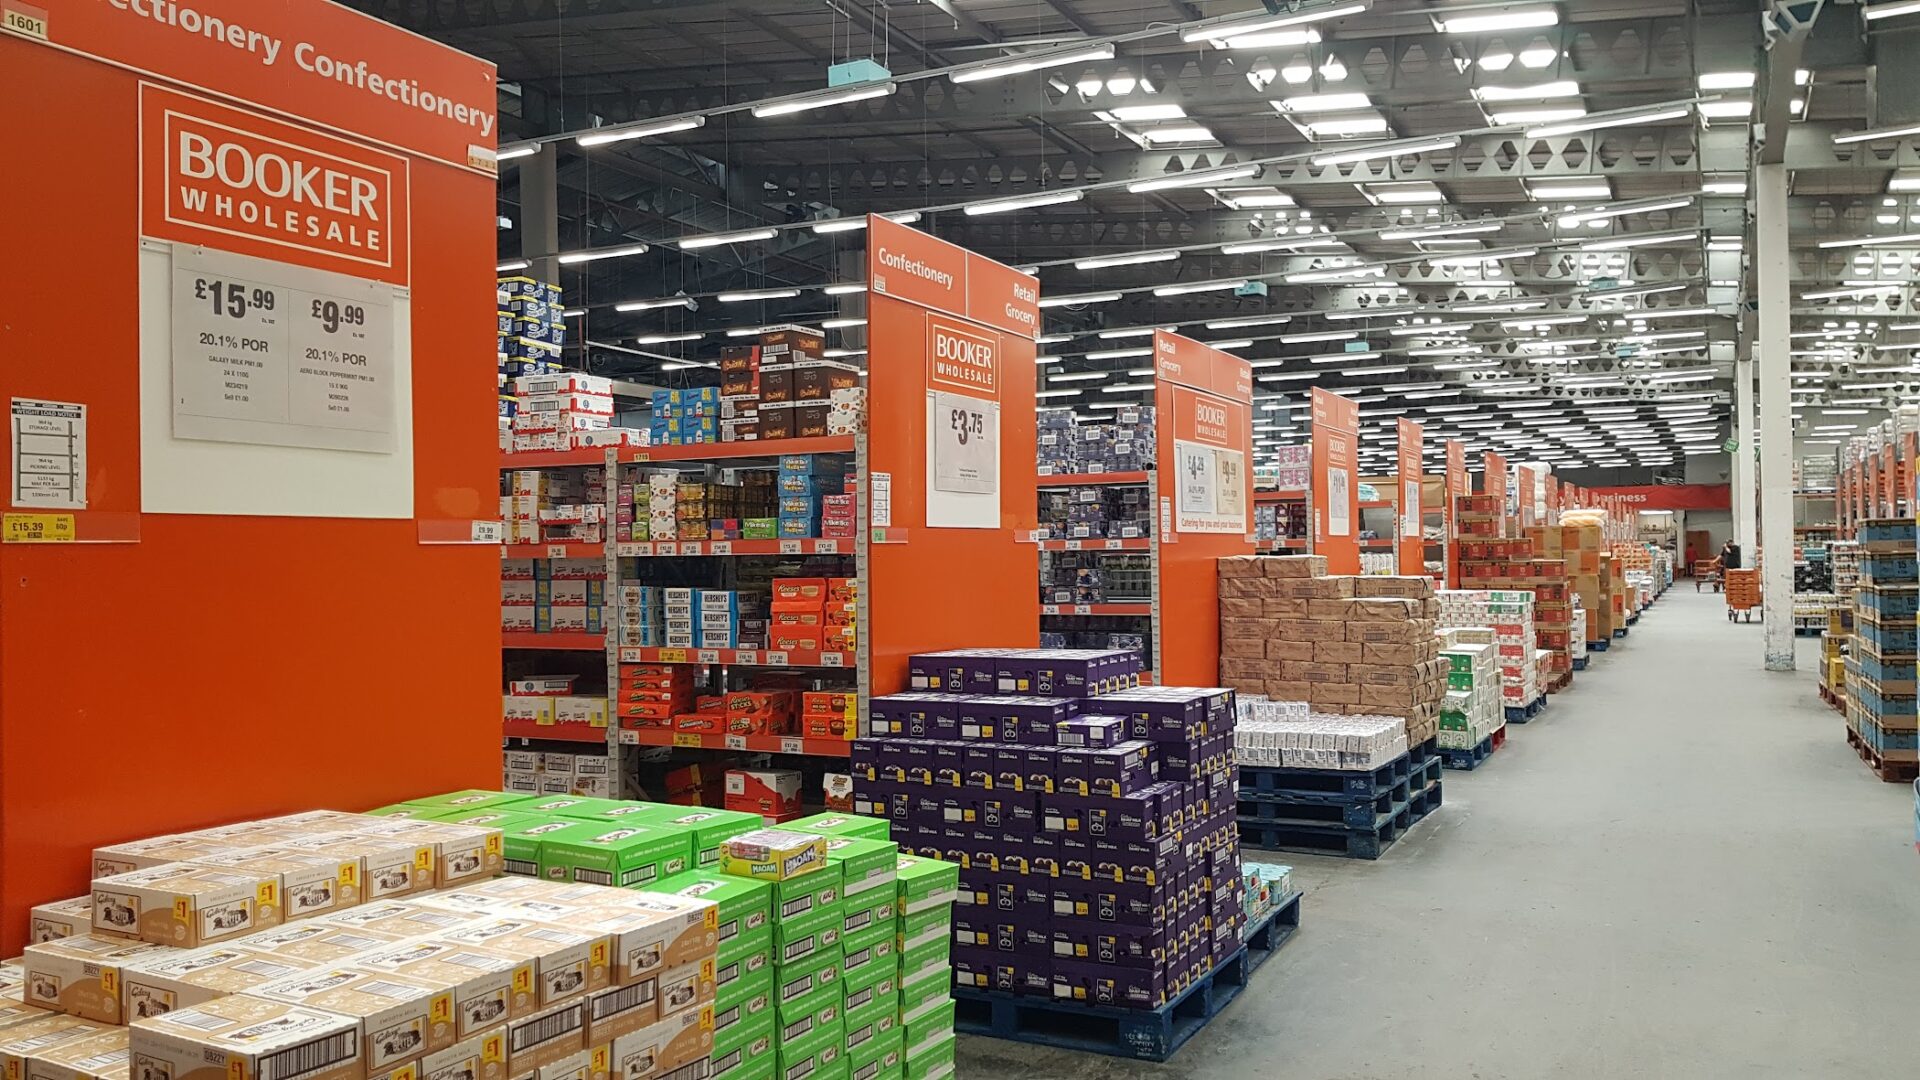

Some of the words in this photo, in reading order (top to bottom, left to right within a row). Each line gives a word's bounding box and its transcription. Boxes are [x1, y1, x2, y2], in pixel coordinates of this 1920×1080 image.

[8, 13, 43, 34] 1601
[294, 43, 494, 136] Confectionery
[179, 131, 379, 221] BOOKER
[180, 186, 380, 250] WHOLESALE
[879, 248, 953, 290] Confectionery
[195, 278, 275, 319] £15.99
[1014, 283, 1036, 303] Retail
[311, 299, 365, 334] £9.99
[1005, 303, 1036, 325] Grocery
[199, 332, 238, 349] 20.1%
[242, 338, 269, 352] POR
[1159, 339, 1176, 354] Retail
[305, 347, 340, 363] 20.1%
[342, 353, 367, 366] POR
[937, 334, 992, 369] BOOKER
[230, 358, 243, 366] MILK
[1160, 357, 1181, 376] Grocery
[937, 362, 992, 385] WHOLESALE
[1197, 404, 1225, 426] BOOKER
[951, 409, 983, 445] £3.75
[1197, 425, 1226, 438] WHOLESALE
[1329, 439, 1346, 454] BOOKER
[13, 523, 44, 531] £15.39
[1182, 517, 1199, 530] Catering
[668, 591, 689, 599] HERSHEY'S
[704, 594, 727, 603] HERSHEY'S
[704, 614, 727, 622] HERSHEY'S
[669, 636, 690, 644] HERSHEY'S
[705, 633, 728, 641] HERSHEY'S
[730, 701, 752, 710] STICKS
[489, 836, 498, 850] £1
[419, 851, 428, 866] £1
[343, 866, 353, 881] £1
[752, 863, 777, 874] MAOAM
[261, 884, 272, 900] £1
[176, 901, 186, 918] £1
[708, 909, 716, 926] £1
[594, 945, 604, 961] £1
[704, 961, 713, 977] £1
[105, 973, 114, 991] £1
[517, 970, 528, 987] £1
[435, 998, 447, 1017] £1
[703, 1009, 711, 1026] £1
[487, 1039, 499, 1057] £1
[595, 1050, 604, 1067] £1
[9, 1061, 19, 1079] £1
